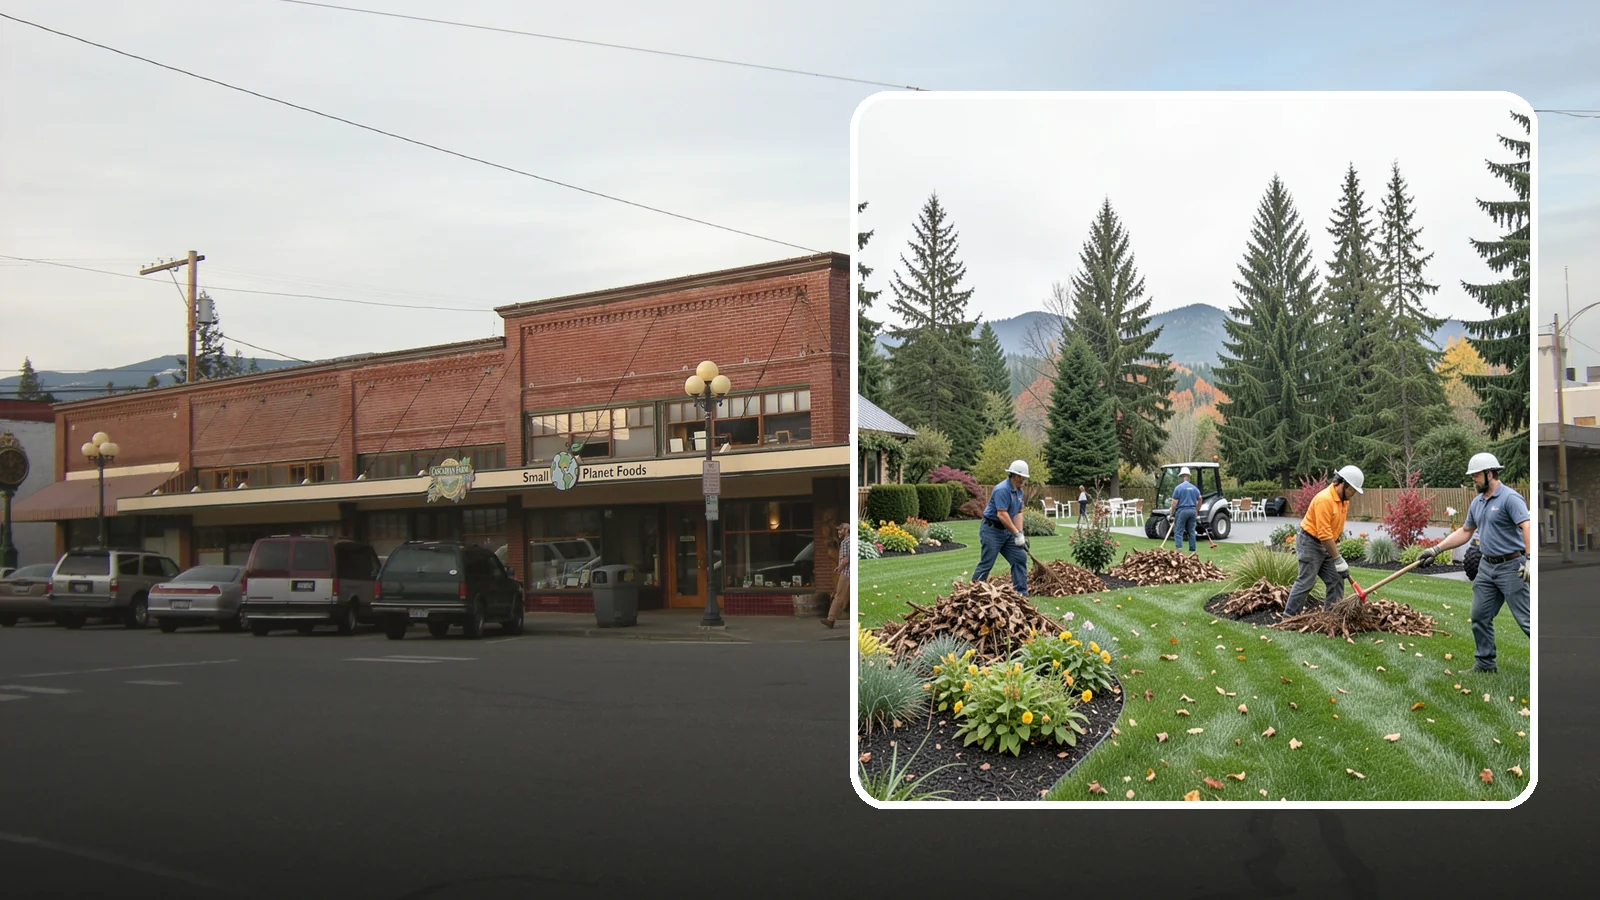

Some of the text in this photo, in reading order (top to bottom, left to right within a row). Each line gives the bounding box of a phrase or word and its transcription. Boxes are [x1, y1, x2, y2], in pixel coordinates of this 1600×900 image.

[523, 464, 647, 483] Small Planet Foods
